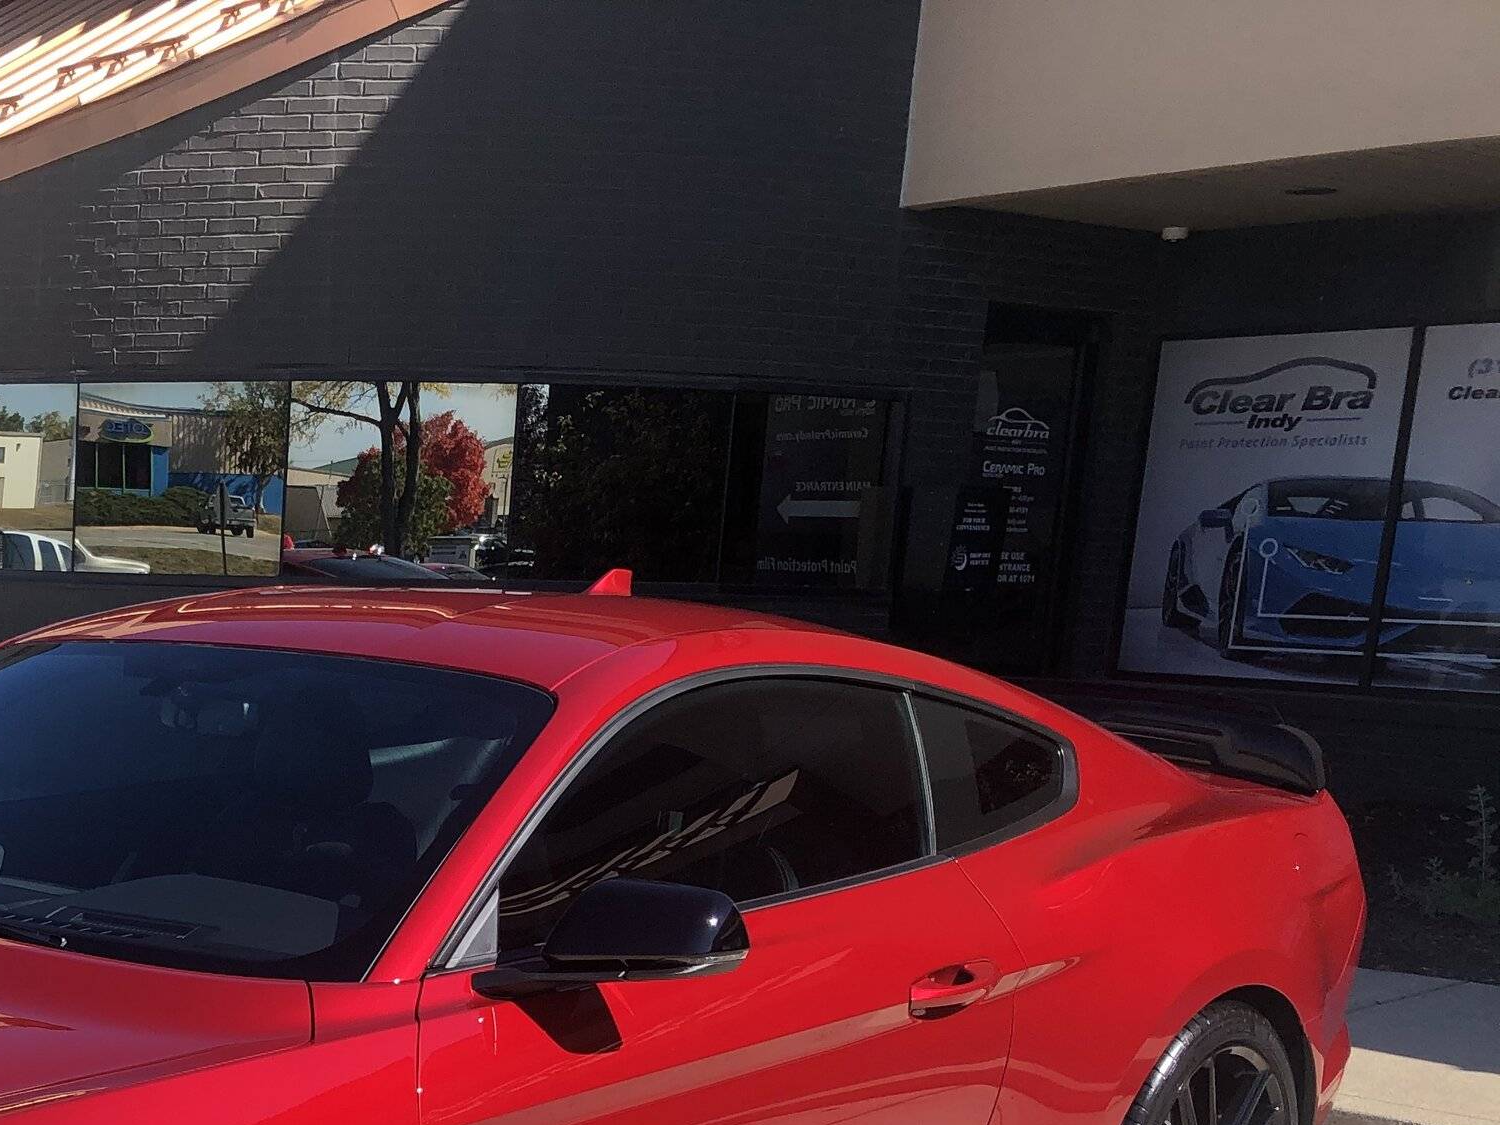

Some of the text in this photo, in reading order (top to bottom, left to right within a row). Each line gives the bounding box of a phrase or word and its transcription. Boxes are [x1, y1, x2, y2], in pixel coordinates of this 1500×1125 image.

[1191, 385, 1375, 416] Clear Bra
[1247, 414, 1303, 432] Indy
[1179, 433, 1368, 450] Paint Protection Specialists
